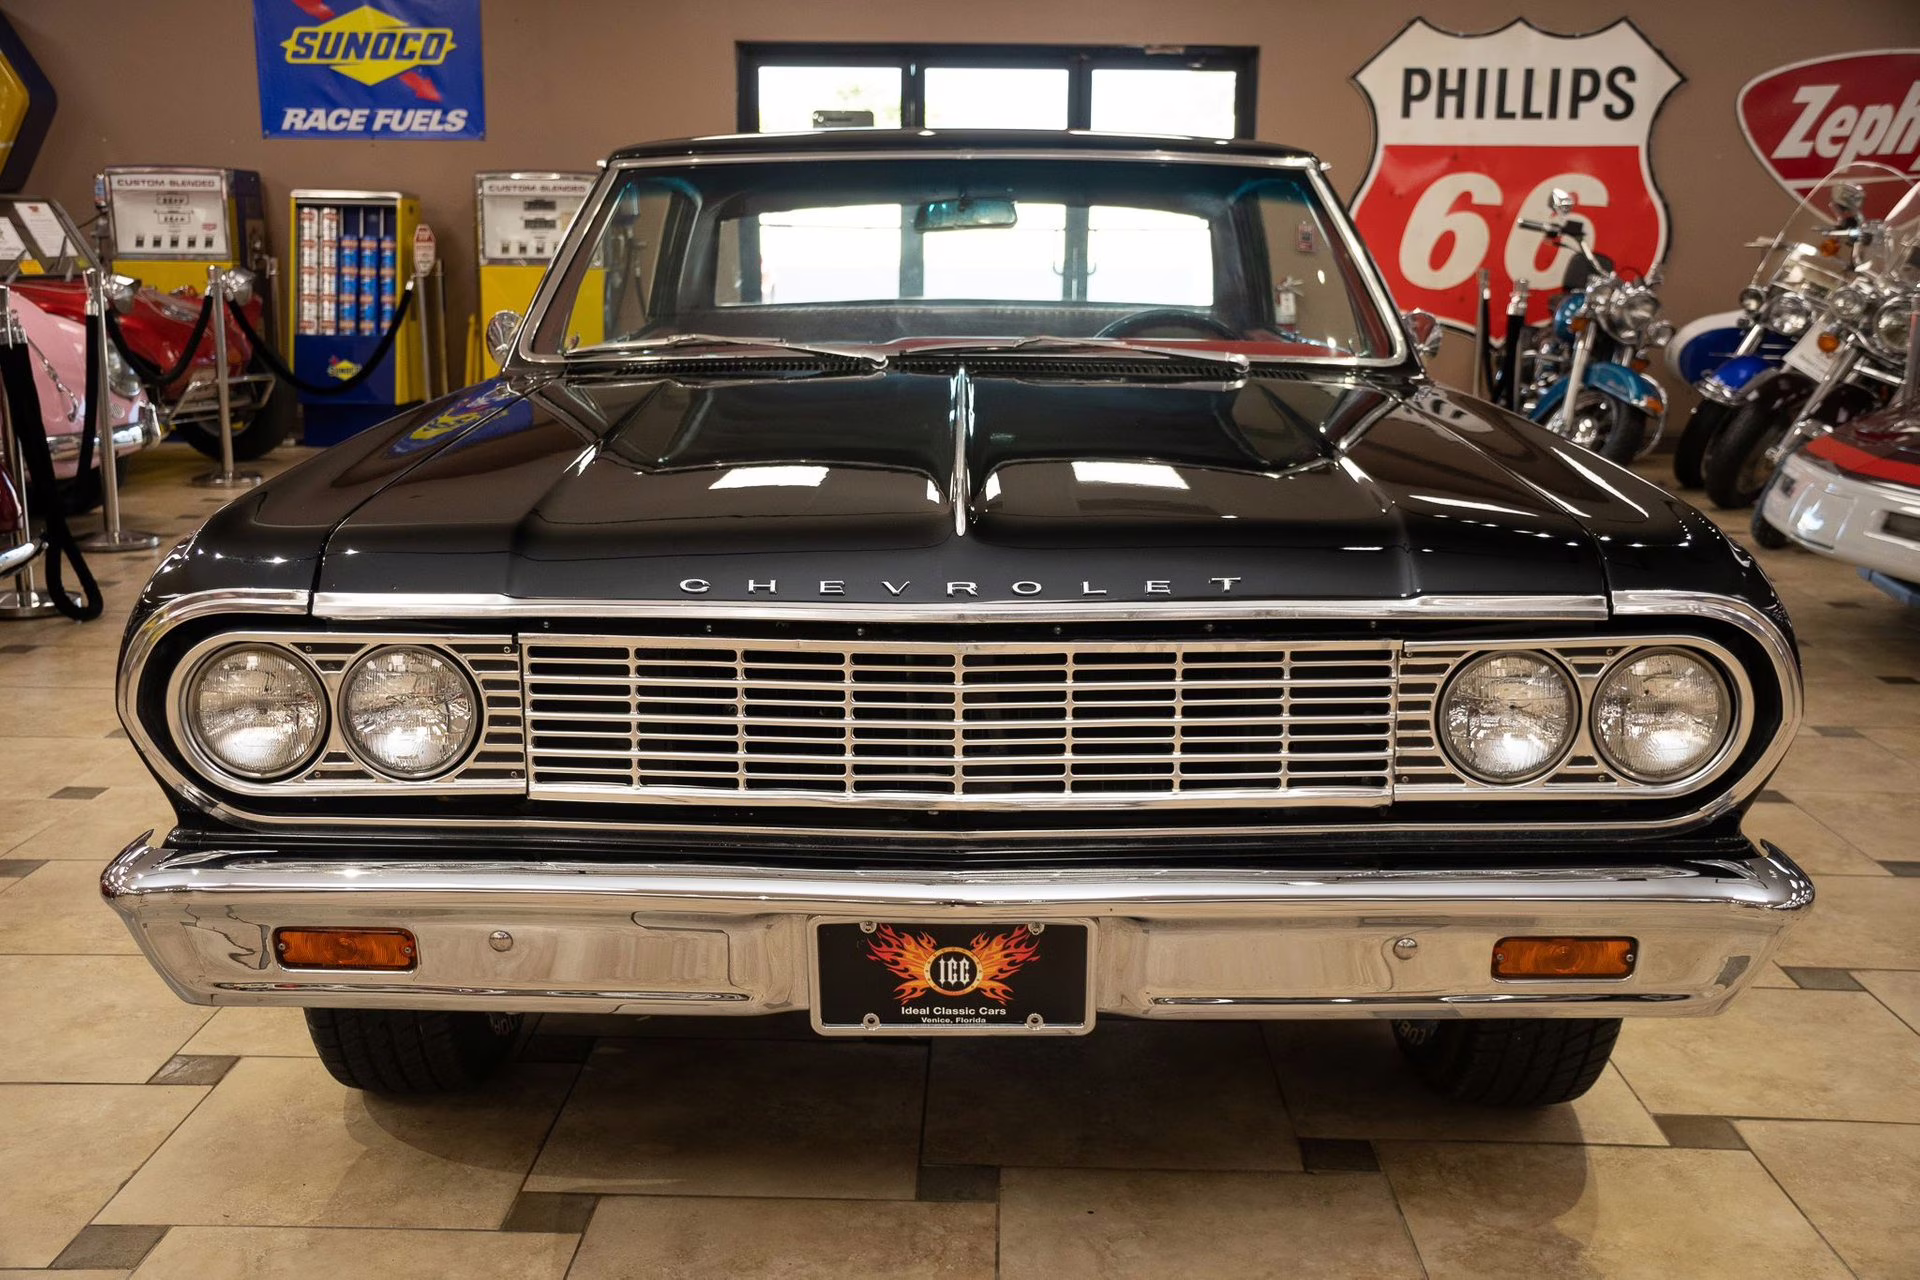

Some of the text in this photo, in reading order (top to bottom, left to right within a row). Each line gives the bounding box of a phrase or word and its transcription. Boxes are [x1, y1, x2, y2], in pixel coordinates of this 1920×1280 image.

[290, 31, 448, 61] SUNOCO
[1400, 65, 1637, 121] PHILLIPS
[281, 107, 469, 133] RACE FUELS
[1770, 80, 1920, 174] Zeph
[117, 179, 215, 188] CUSTOM BLENDED
[488, 185, 536, 193] CUSTOM
[1399, 171, 1610, 291] 66
[679, 576, 1241, 597] CHEVROLET
[938, 956, 970, 987] ICC
[901, 1006, 1007, 1015] Ideal Classic Cars
